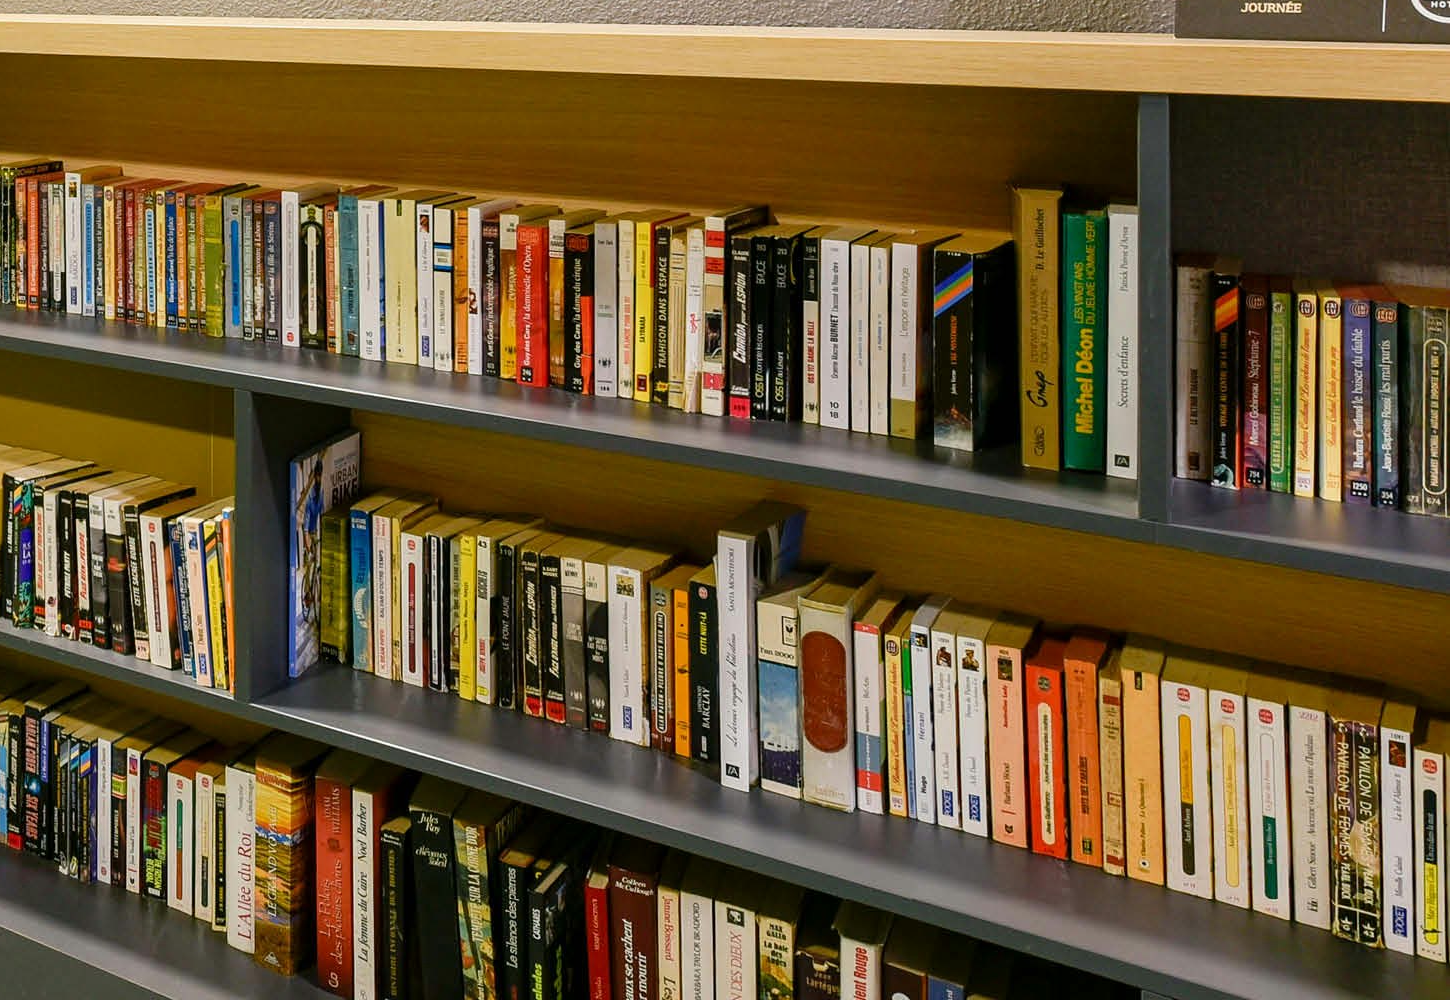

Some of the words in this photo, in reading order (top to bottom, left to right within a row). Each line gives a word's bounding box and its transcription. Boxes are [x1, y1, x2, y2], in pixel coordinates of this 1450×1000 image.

[1240, 1, 1302, 14] JOURNÉE
[658, 256, 668, 295] L'ESPACE
[756, 259, 766, 284] BRUCE
[776, 263, 787, 288] BRUCE
[658, 298, 668, 321] DANS
[807, 320, 816, 336] BELLE
[1352, 328, 1365, 354] diable
[573, 341, 582, 353] des
[658, 325, 668, 368] TRAHISON
[1074, 327, 1095, 374] Déon
[1116, 335, 1130, 376] d'enfance
[1352, 355, 1365, 368] du
[1116, 378, 1130, 408] Secrets
[1352, 369, 1365, 393] baiser
[829, 401, 840, 409] 10
[829, 411, 840, 419] 18
[1074, 377, 1095, 434] Michel
[1352, 405, 1365, 437] Cartland
[1352, 438, 1365, 468] Barbara
[1352, 482, 1369, 491] 1250
[701, 686, 711, 729] BARCLAY
[1337, 742, 1350, 792] PAVILLON
[920, 775, 928, 794] Hugo
[1337, 797, 1350, 811] DE
[357, 802, 367, 836] Barber
[237, 831, 252, 858] Roi
[1337, 814, 1350, 856] FEMMES
[357, 839, 368, 863] Noel
[465, 845, 480, 872] CORNE
[237, 861, 252, 879] du
[467, 874, 481, 885] LA
[357, 871, 368, 898] Caire
[467, 886, 482, 902] SUR
[505, 867, 521, 901] pierres
[237, 883, 252, 939] L'Allée
[268, 903, 278, 917] LE
[357, 900, 368, 912] du
[505, 900, 518, 919] des
[357, 913, 371, 949] femme
[506, 919, 519, 954] silence
[621, 918, 634, 961] cachent
[357, 948, 369, 962] La
[506, 955, 519, 967] Le
[730, 930, 743, 969] DIEUX
[853, 946, 869, 979] Rouge
